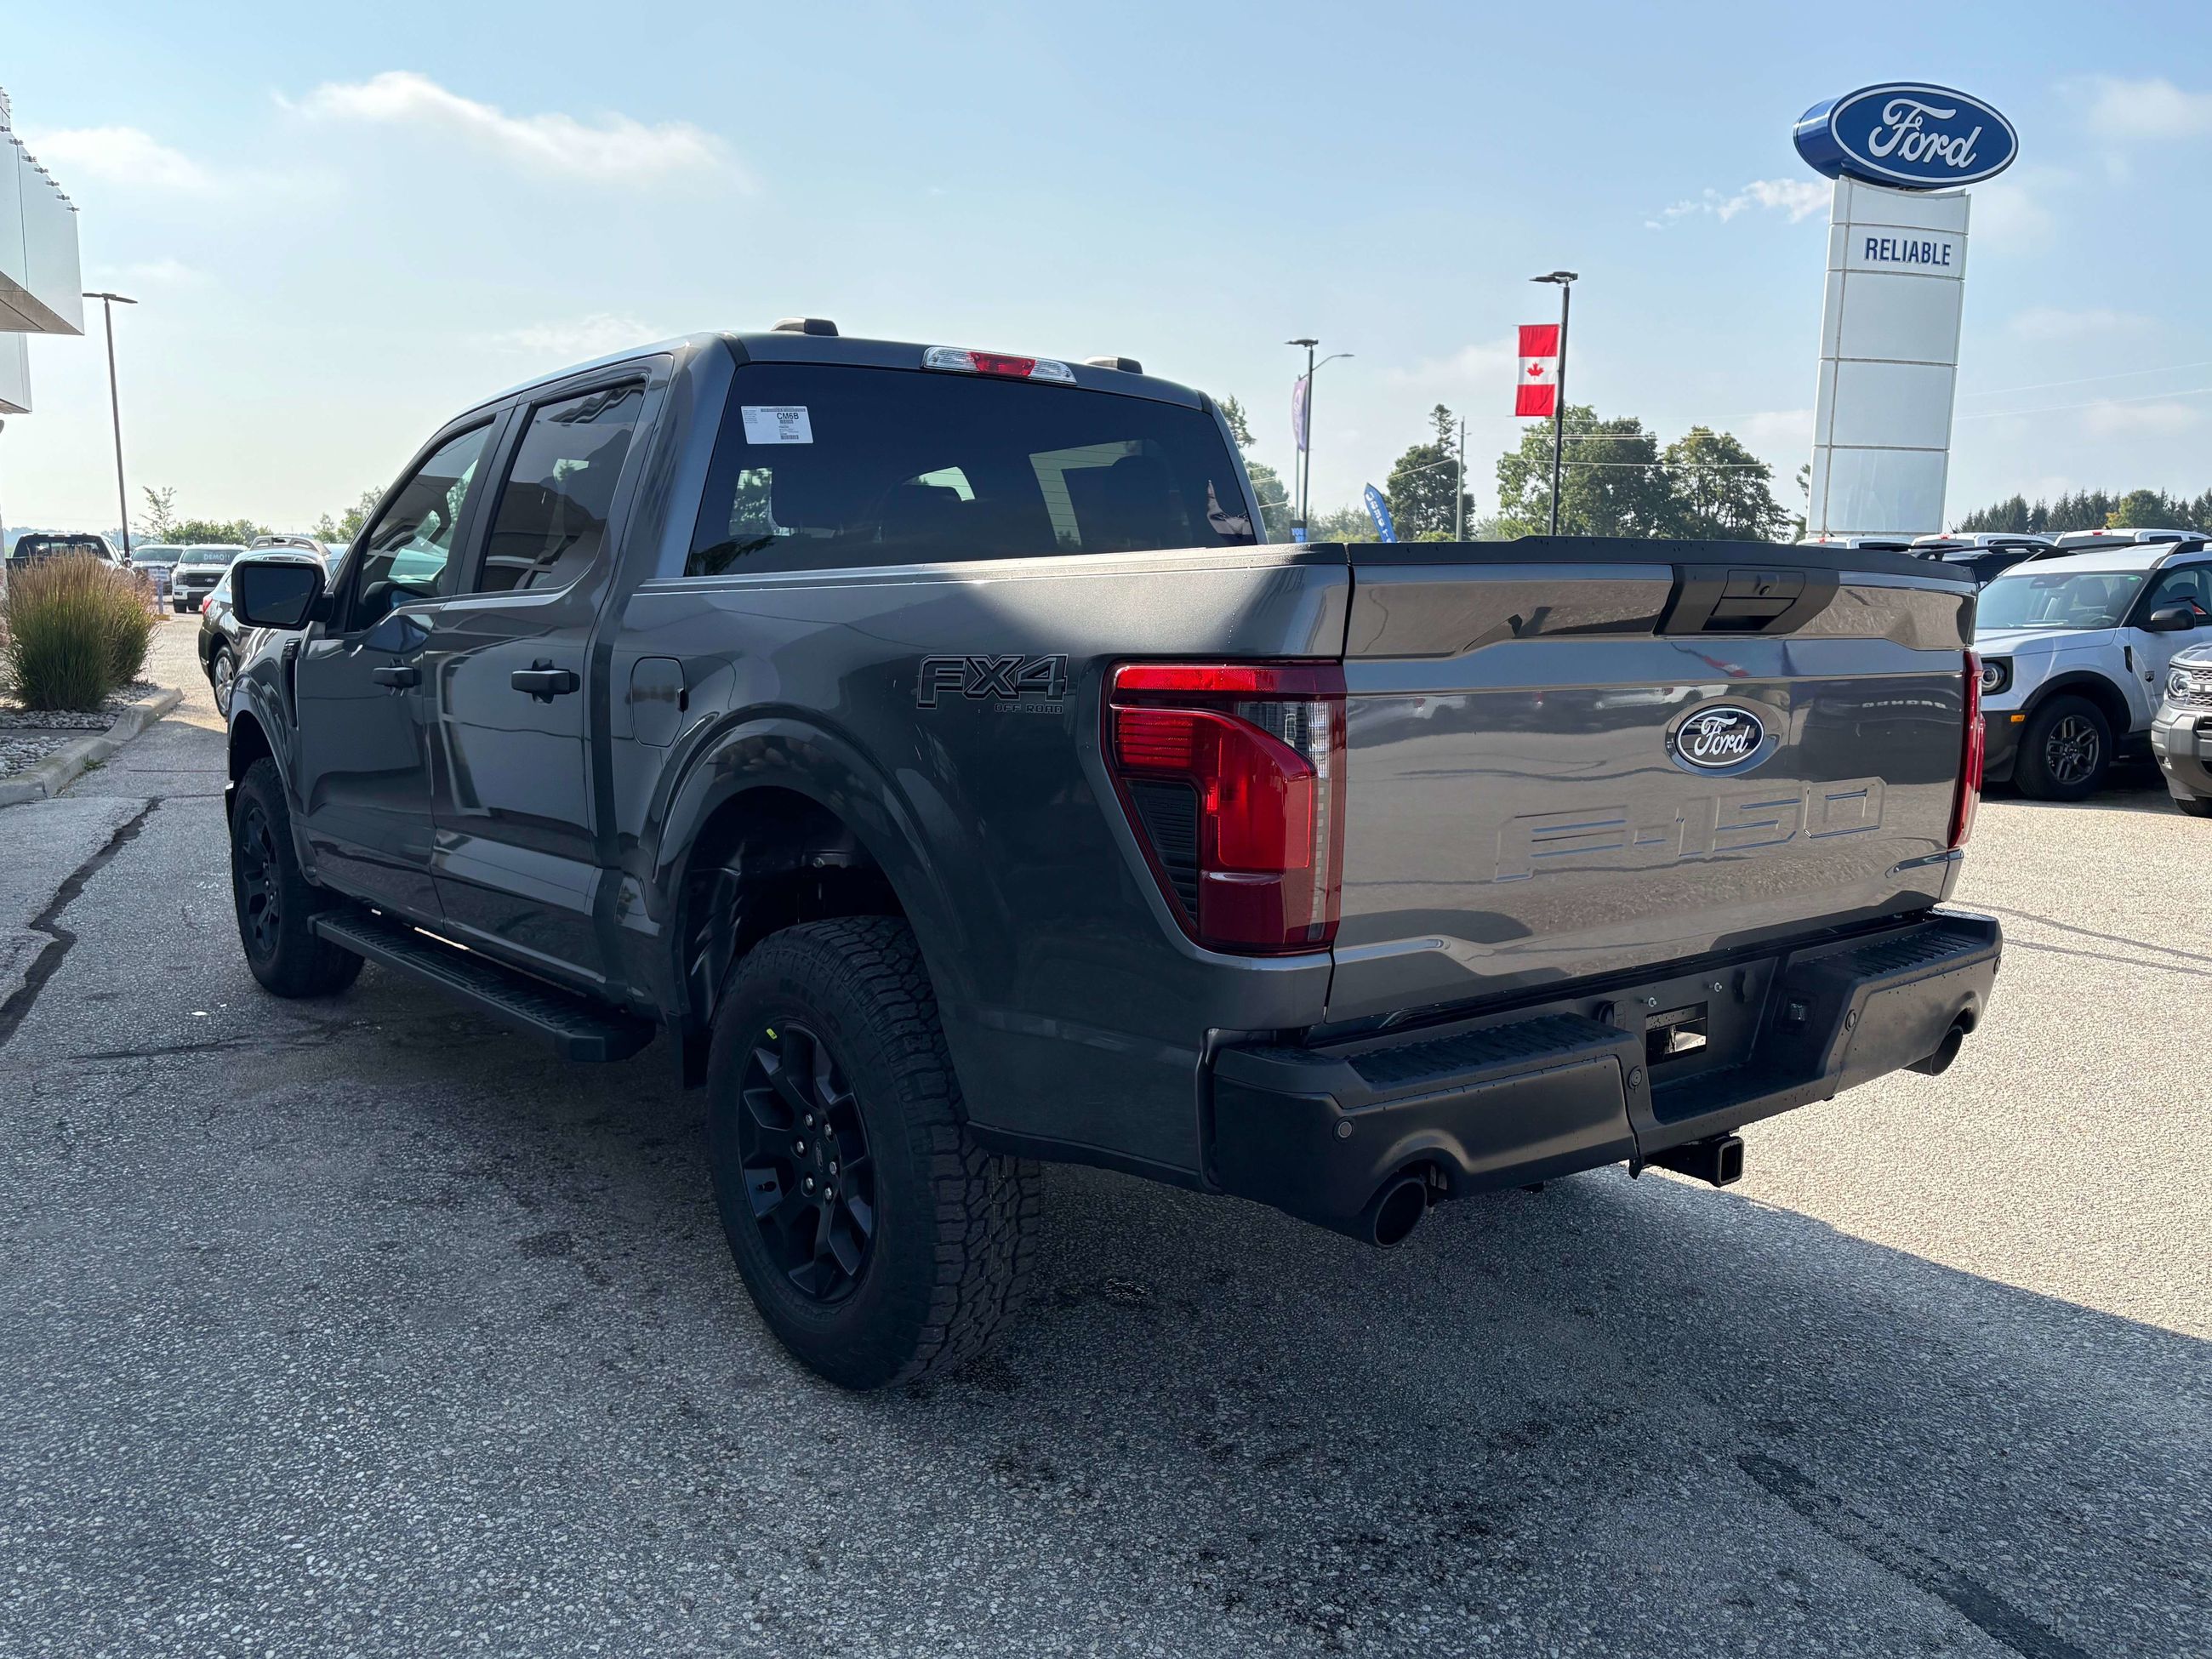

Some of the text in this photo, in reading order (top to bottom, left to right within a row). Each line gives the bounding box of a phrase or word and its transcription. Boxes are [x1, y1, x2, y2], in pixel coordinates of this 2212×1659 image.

[1867, 97, 1983, 168] Ford
[1863, 237, 1953, 266] RELIABLE
[776, 412, 800, 420] CM6B
[916, 653, 1069, 710] FX4
[994, 703, 1063, 714] OFF ROAD
[1693, 715, 1751, 756] Ford
[1494, 776, 1888, 881] F-150
